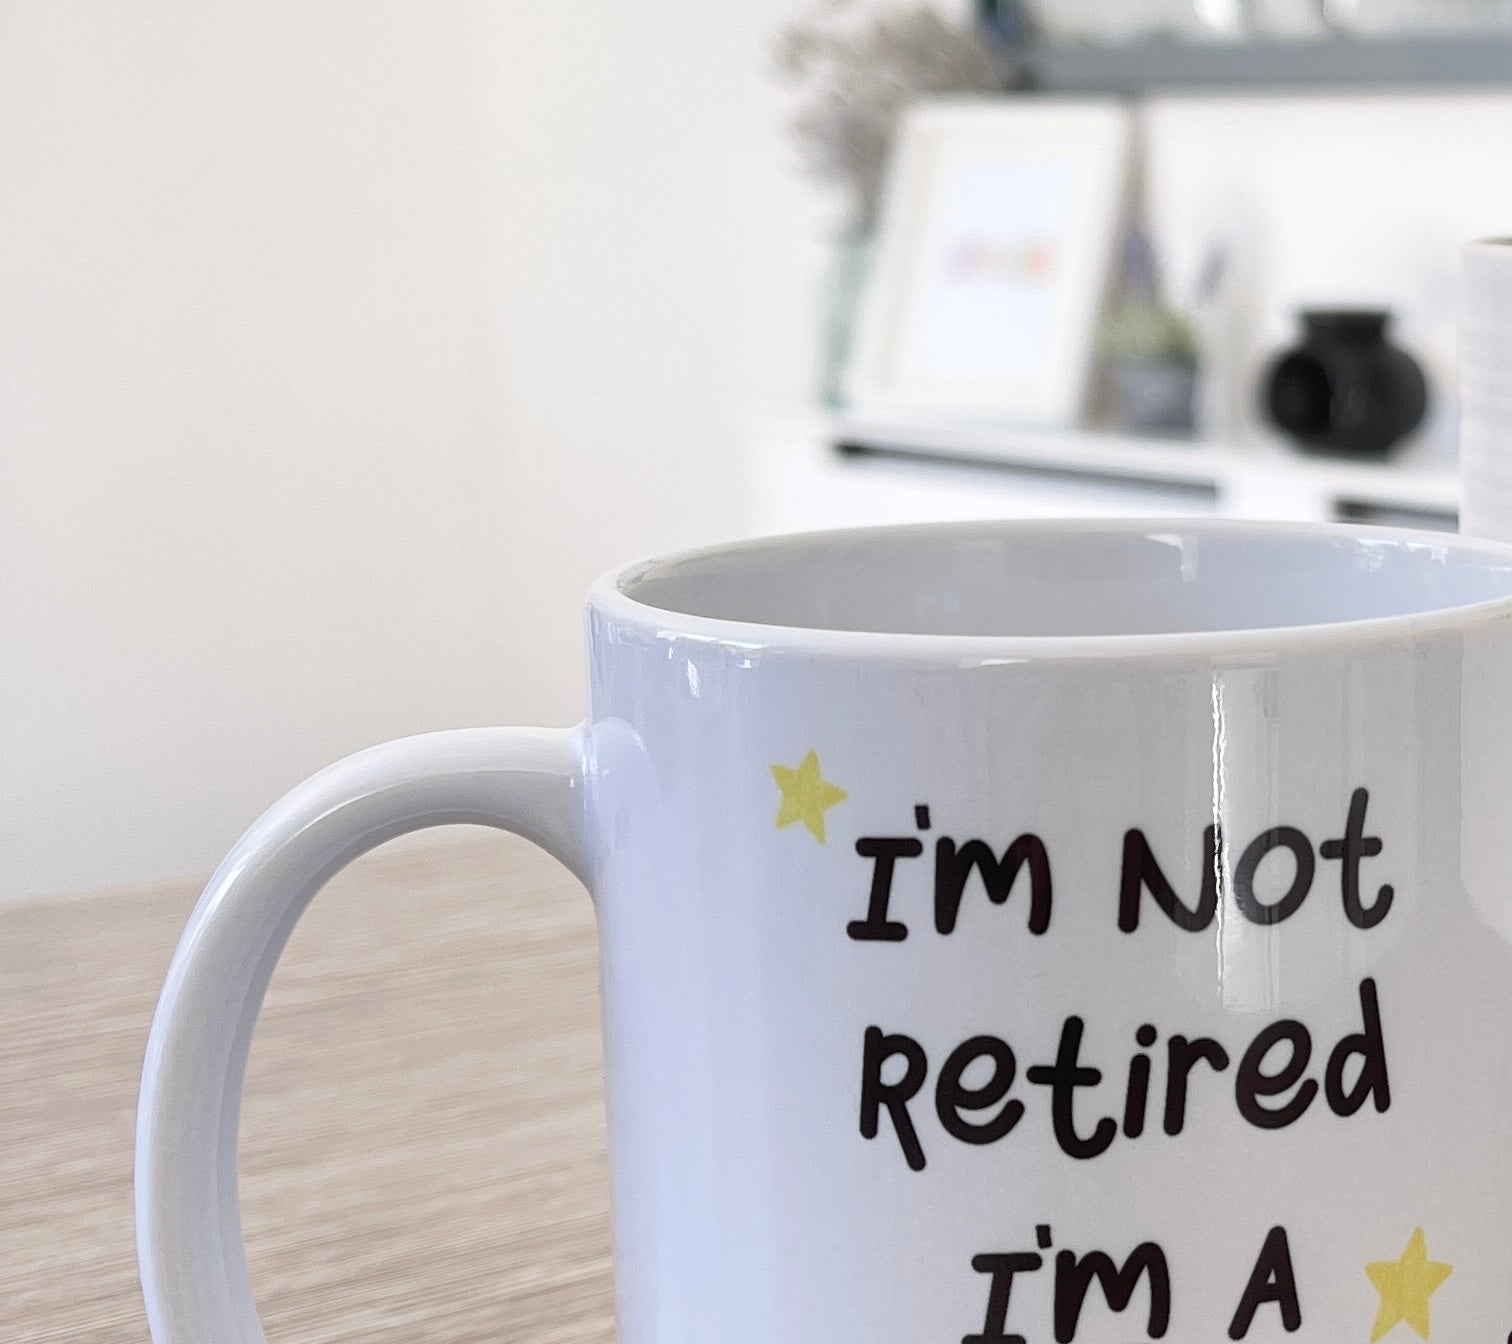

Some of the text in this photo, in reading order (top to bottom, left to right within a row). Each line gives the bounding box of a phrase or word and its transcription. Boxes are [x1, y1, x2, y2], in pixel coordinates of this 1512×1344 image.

[845, 786, 1396, 944] I'm Not
[858, 975, 1392, 1173] Retired
[1226, 1224, 1303, 1343] A
